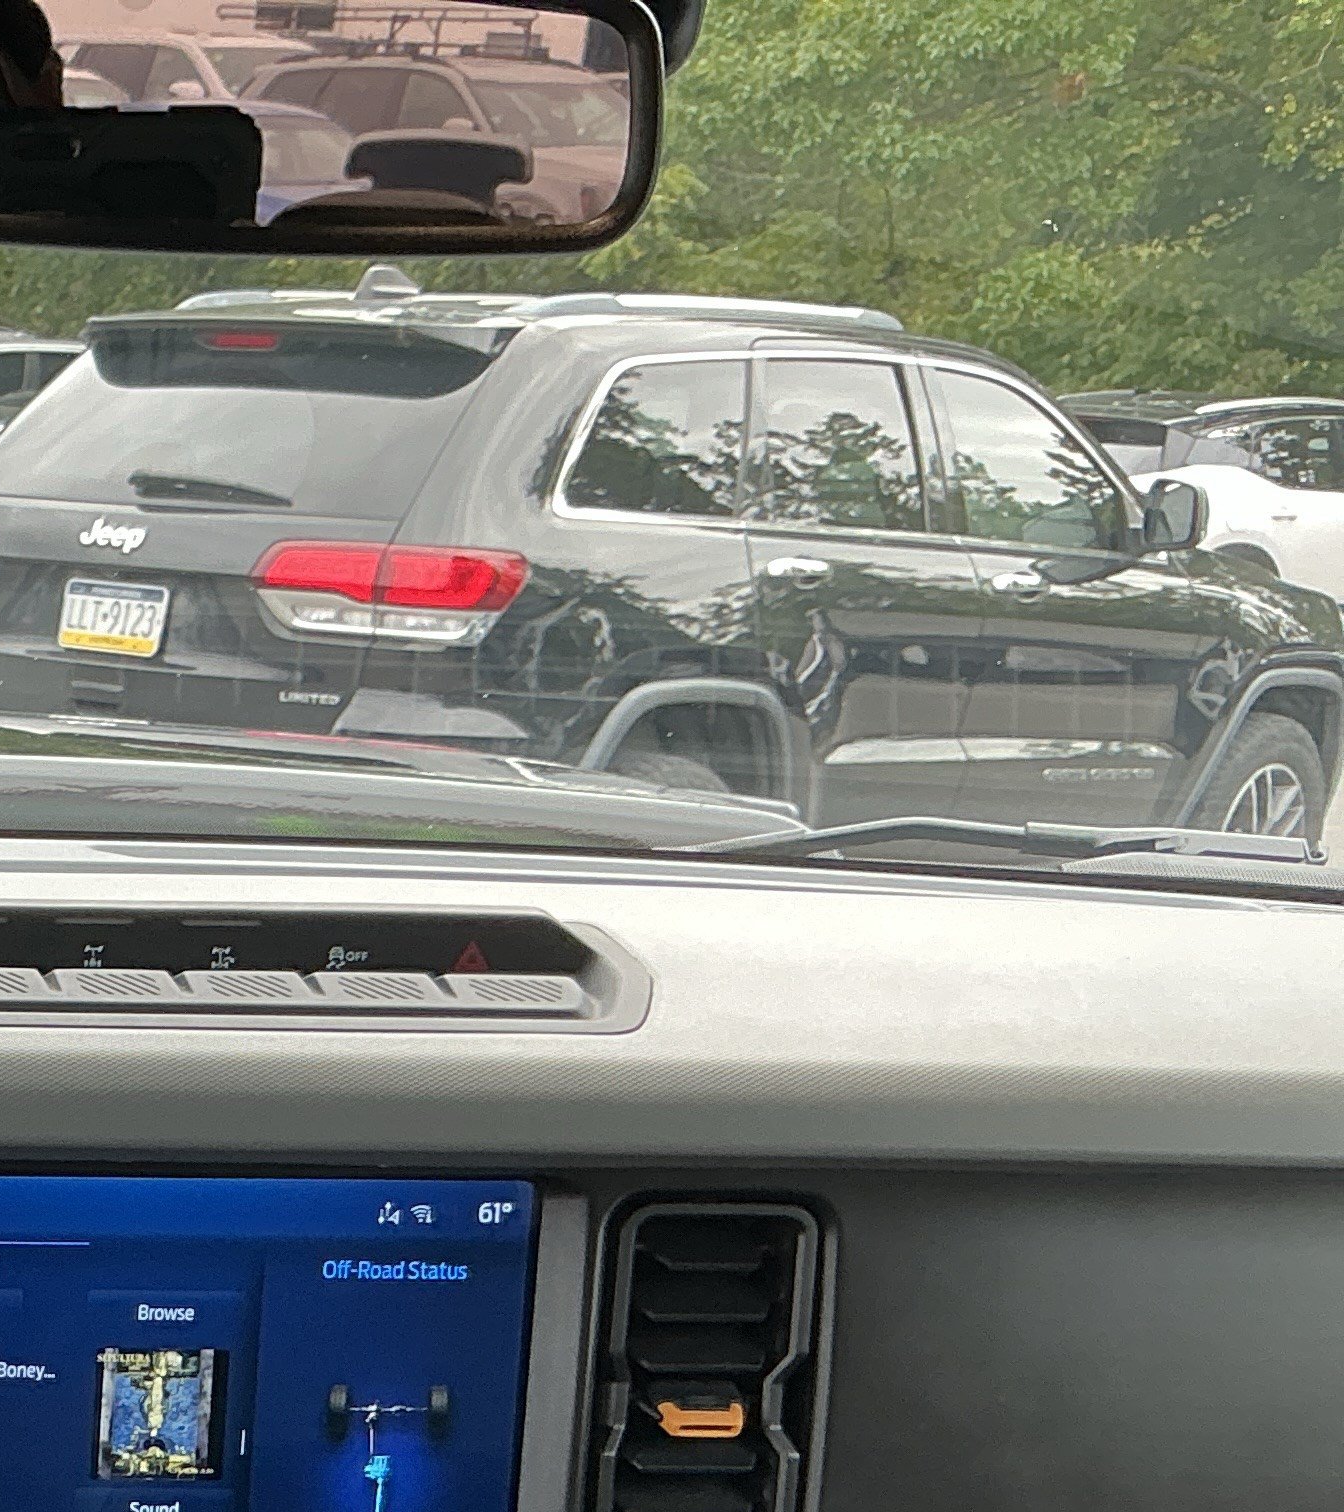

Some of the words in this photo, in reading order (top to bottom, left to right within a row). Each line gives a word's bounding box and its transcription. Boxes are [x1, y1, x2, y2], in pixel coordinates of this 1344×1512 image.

[79, 518, 146, 554] Jeep
[345, 951, 369, 962] OFF
[322, 1260, 405, 1280] Off-Road
[407, 1261, 468, 1281] Status
[137, 1304, 195, 1323] Browse
